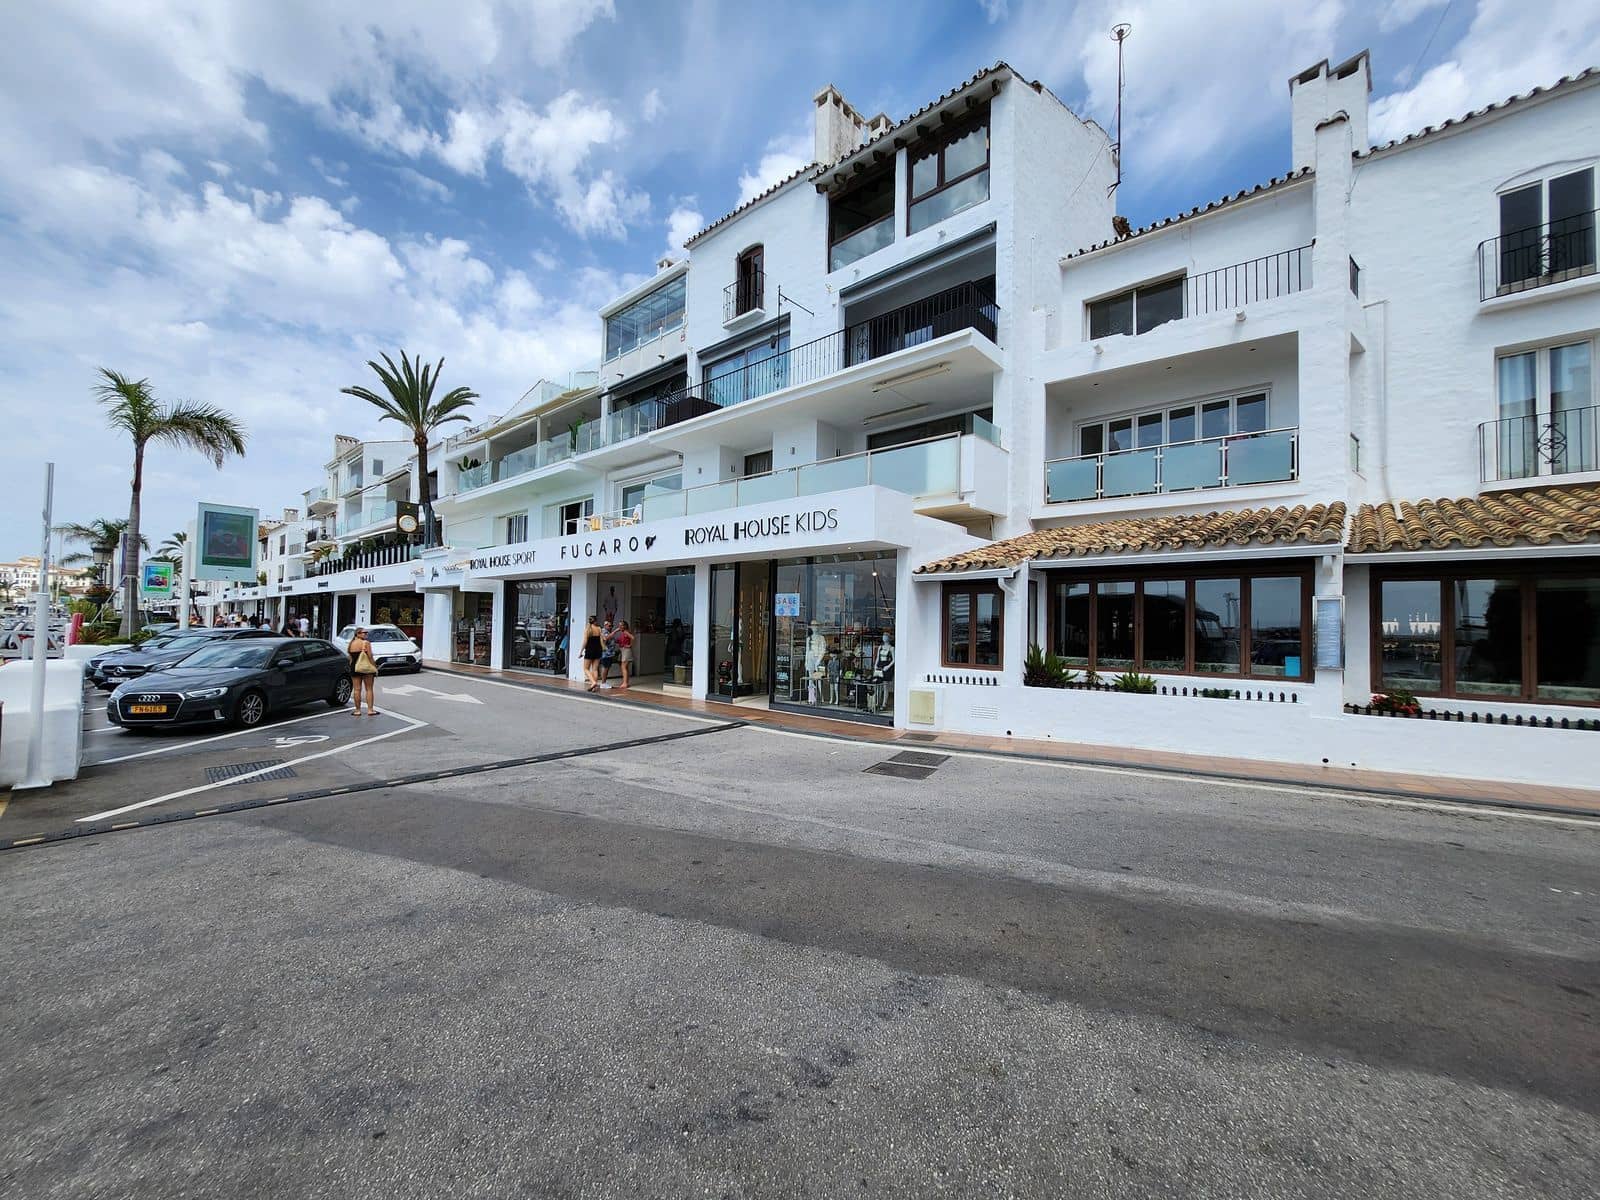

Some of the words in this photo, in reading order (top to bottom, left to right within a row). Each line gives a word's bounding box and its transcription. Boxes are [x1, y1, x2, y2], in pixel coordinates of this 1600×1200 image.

[684, 524, 729, 546] ROYAL
[733, 515, 790, 540] HOUSE
[796, 508, 838, 533] KIDS
[560, 536, 639, 559] FUGARO
[470, 559, 488, 570] ROYAL
[489, 554, 511, 568] HOUSE
[512, 551, 536, 565] SPORT
[776, 597, 797, 605] SALE
